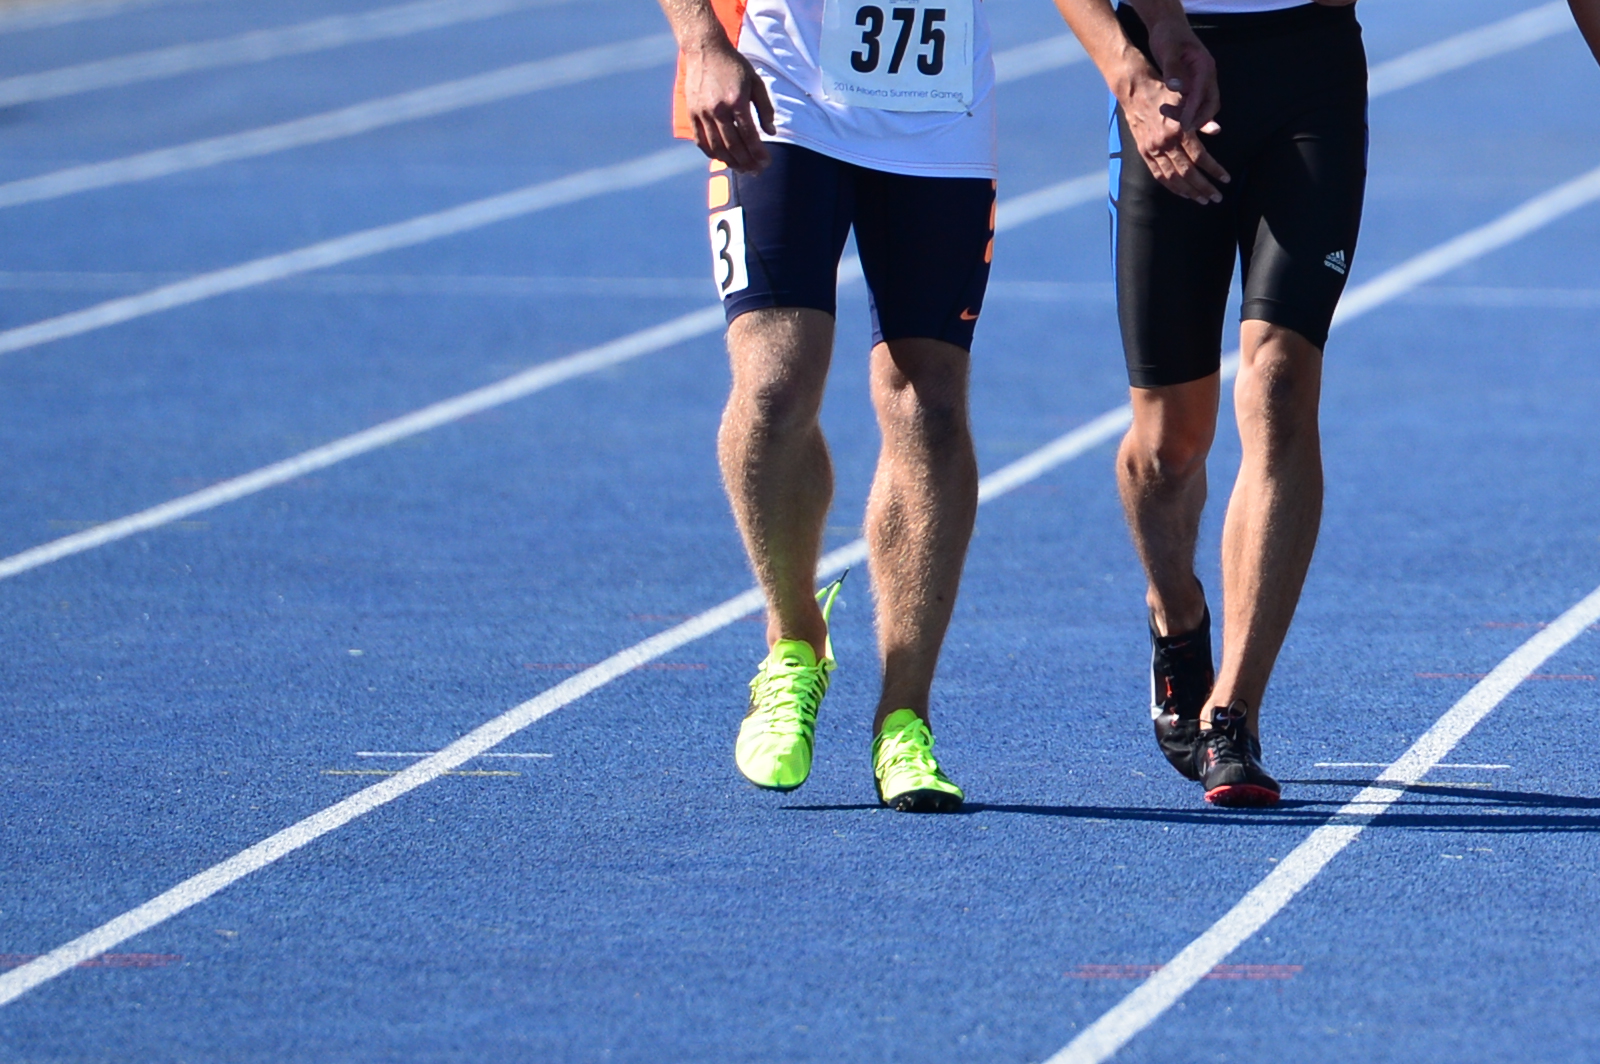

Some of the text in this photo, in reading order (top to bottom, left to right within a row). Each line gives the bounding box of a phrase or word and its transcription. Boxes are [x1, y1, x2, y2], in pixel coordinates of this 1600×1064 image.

[850, 5, 946, 76] 375
[833, 81, 855, 93] 2014
[856, 86, 888, 97] Alberta
[889, 88, 929, 98] Summer
[716, 218, 735, 292] 3
